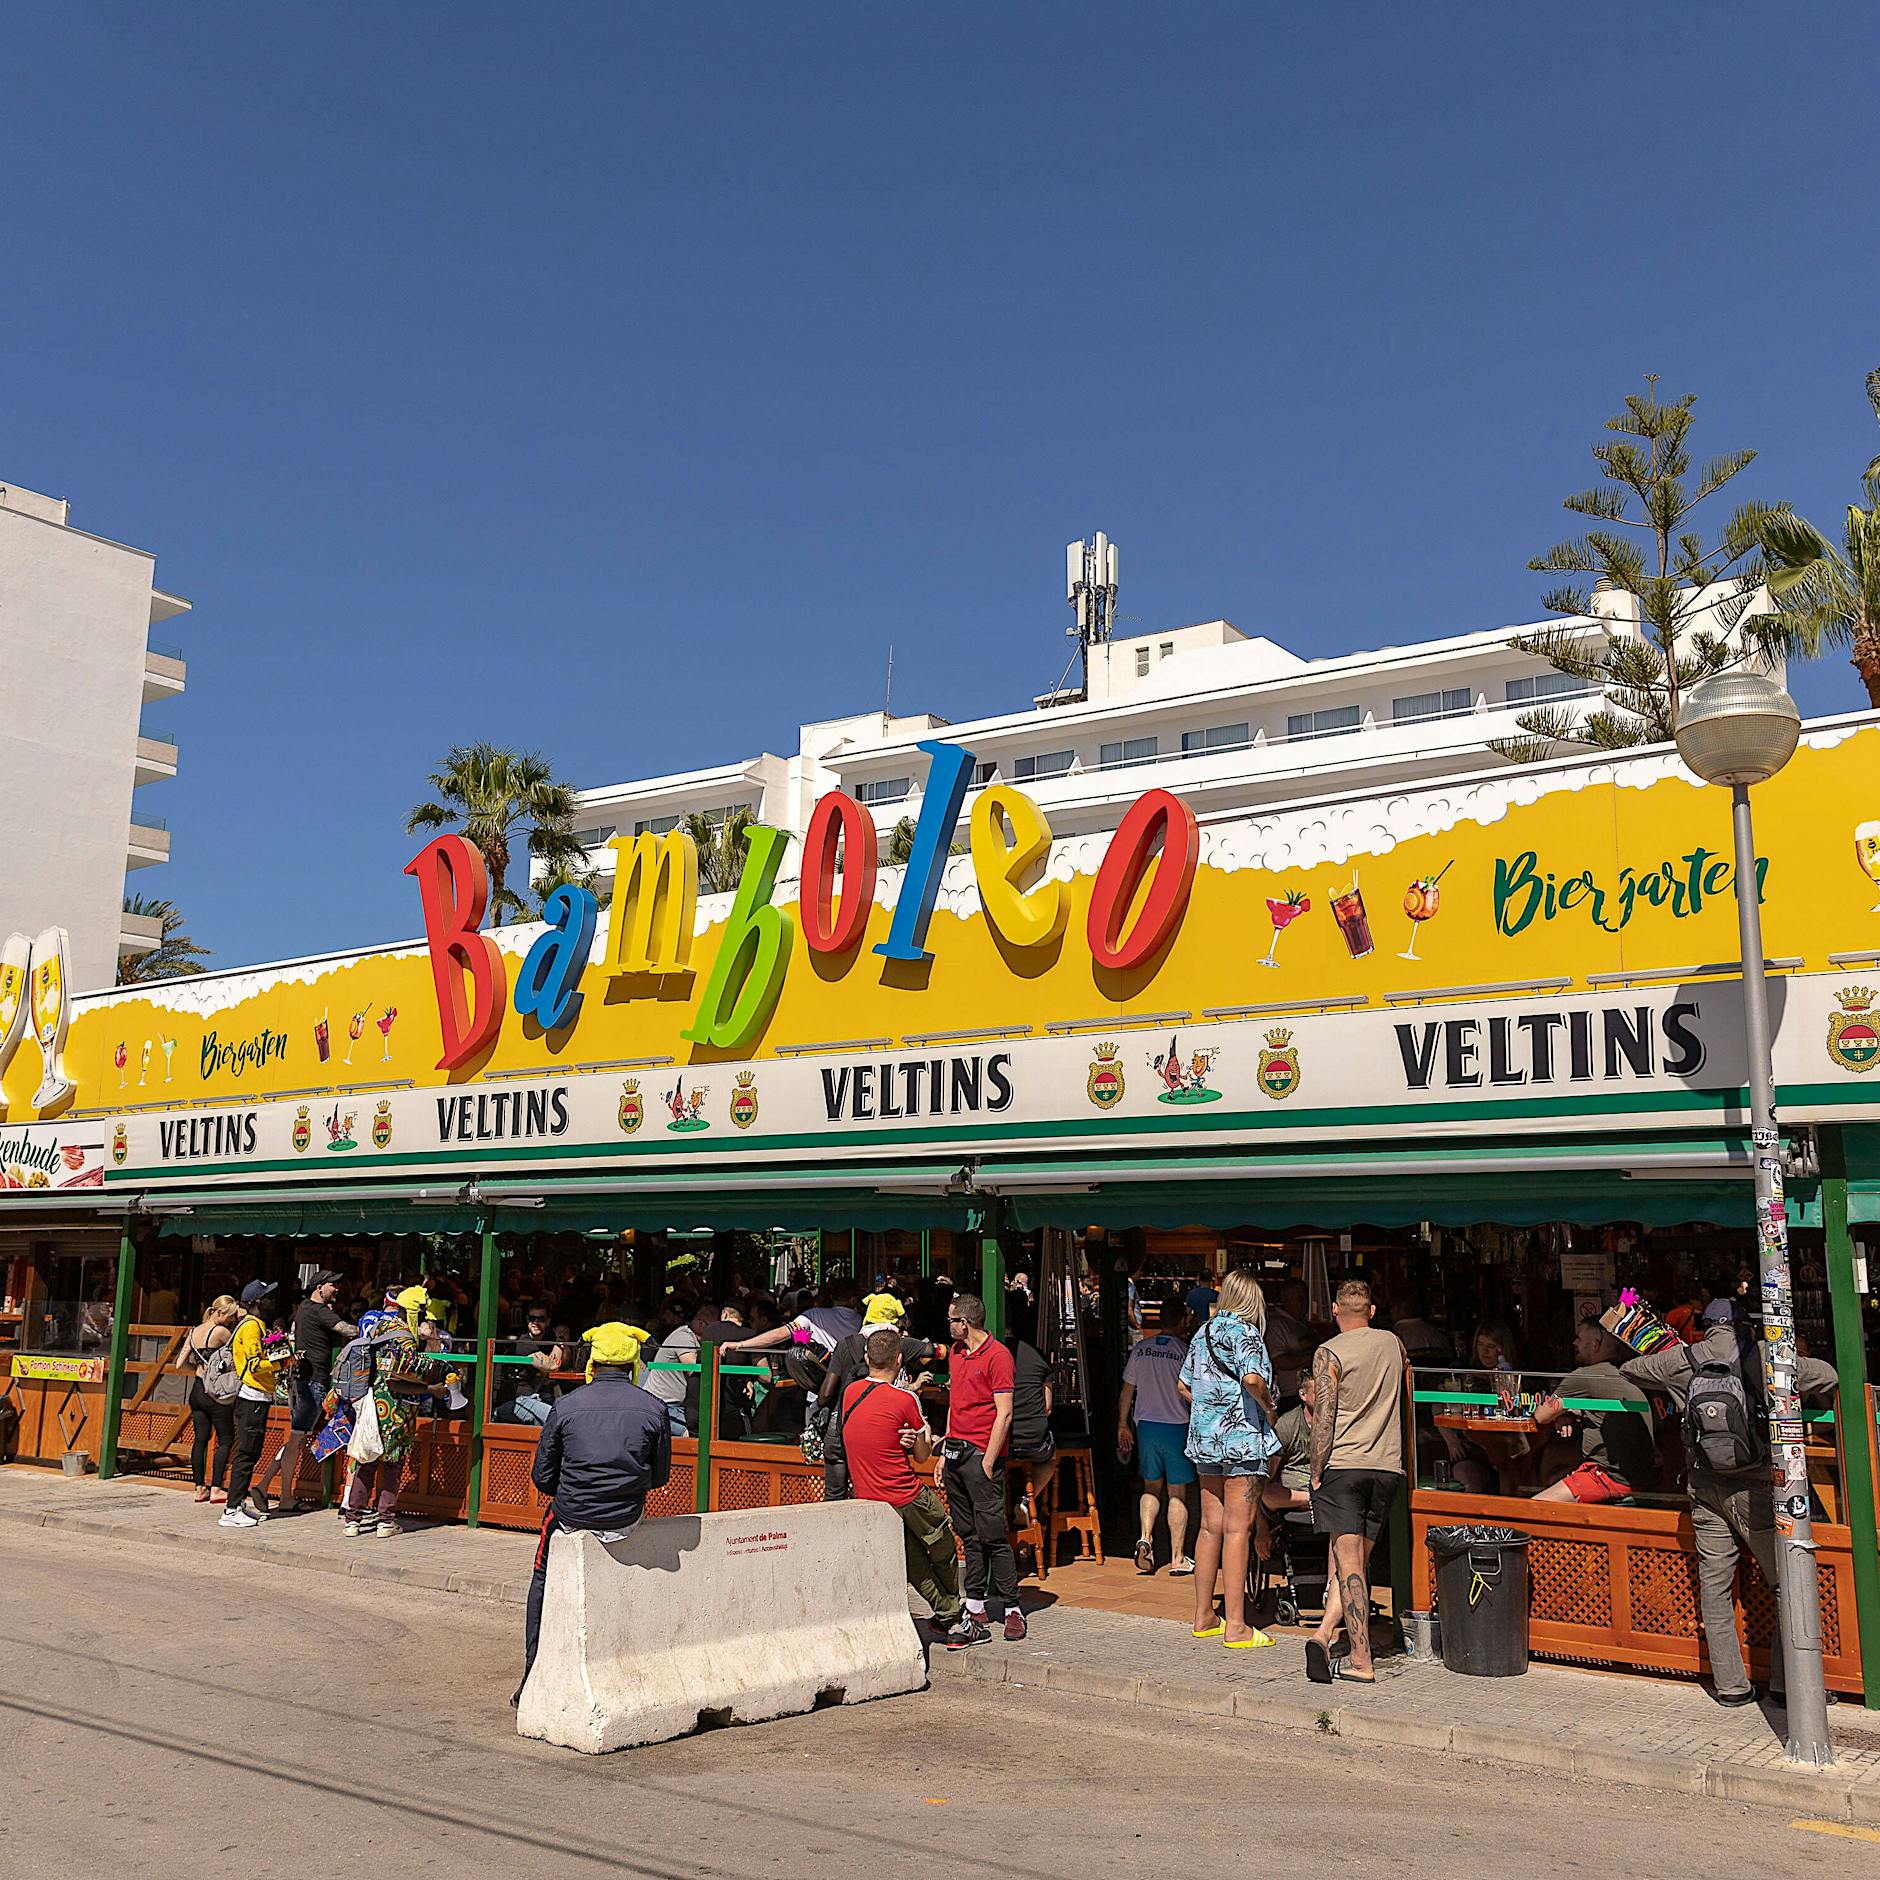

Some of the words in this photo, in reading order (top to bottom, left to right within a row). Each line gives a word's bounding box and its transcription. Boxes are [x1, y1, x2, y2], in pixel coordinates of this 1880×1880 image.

[403, 739, 1201, 1070] Bamboleo
[200, 1028, 288, 1080] Biergarten
[1393, 1002, 1707, 1091] VELTINS
[436, 1086, 570, 1143] VELTINS
[820, 1052, 1014, 1122] VELTINS
[159, 1112, 258, 1161] VELTINS
[760, 1533, 767, 1541] de
[768, 1532, 787, 1540] Palma
